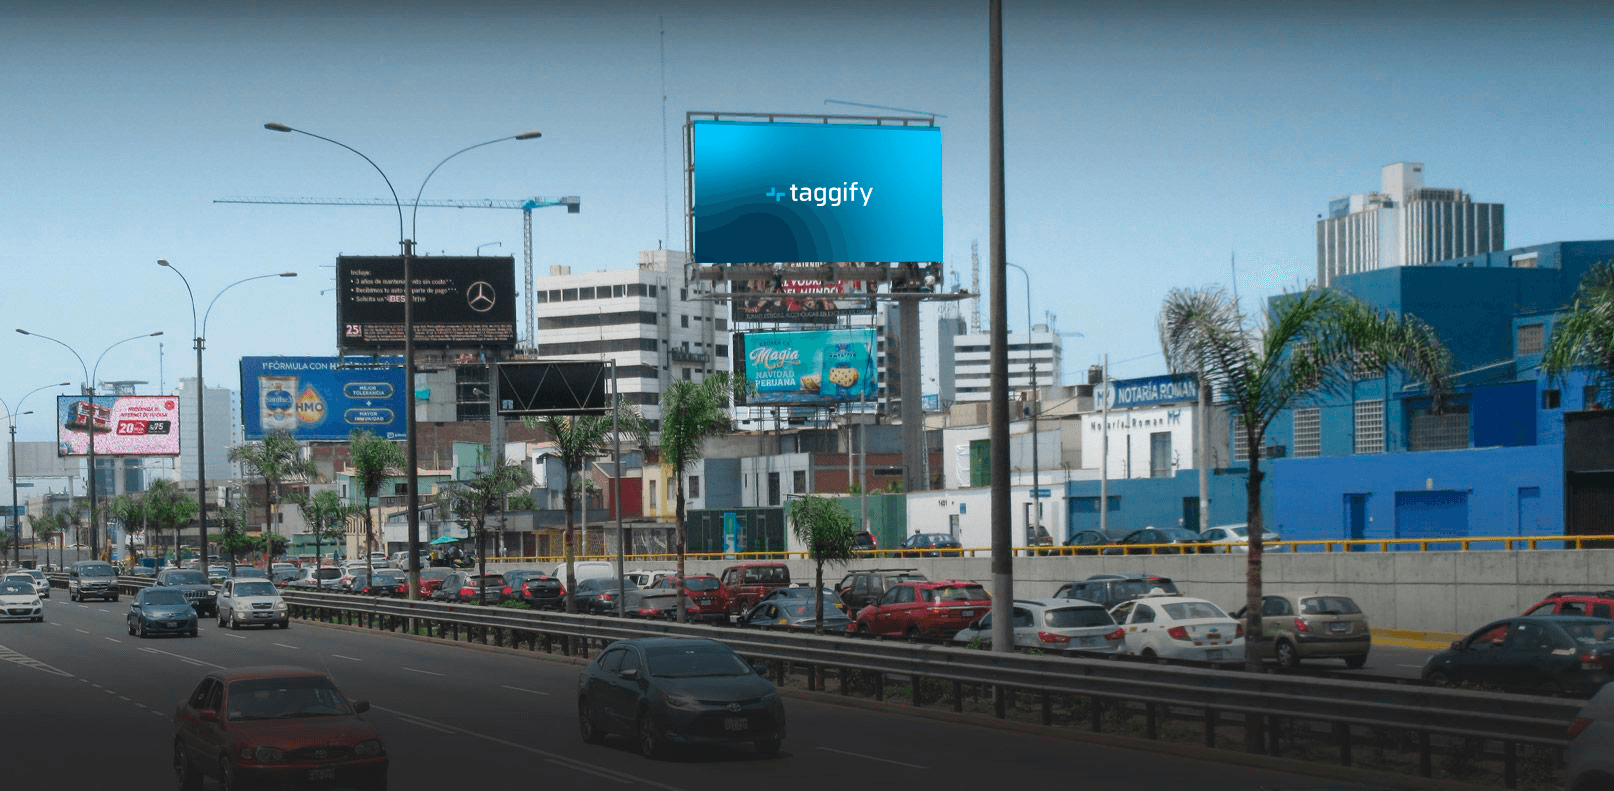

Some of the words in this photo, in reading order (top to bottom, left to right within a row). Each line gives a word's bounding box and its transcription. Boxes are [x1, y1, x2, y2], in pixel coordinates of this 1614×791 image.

[790, 182, 873, 206] taggify
[749, 347, 800, 368] Magia
[269, 361, 308, 370] FÓRMULA
[309, 362, 328, 370] CON
[756, 370, 795, 379] NAVIDAD
[755, 378, 796, 387] PERUANA
[1118, 381, 1158, 403] NOTARÍA
[1160, 380, 1196, 399] ROMAN
[295, 402, 324, 412] HMO
[118, 422, 134, 433] 20
